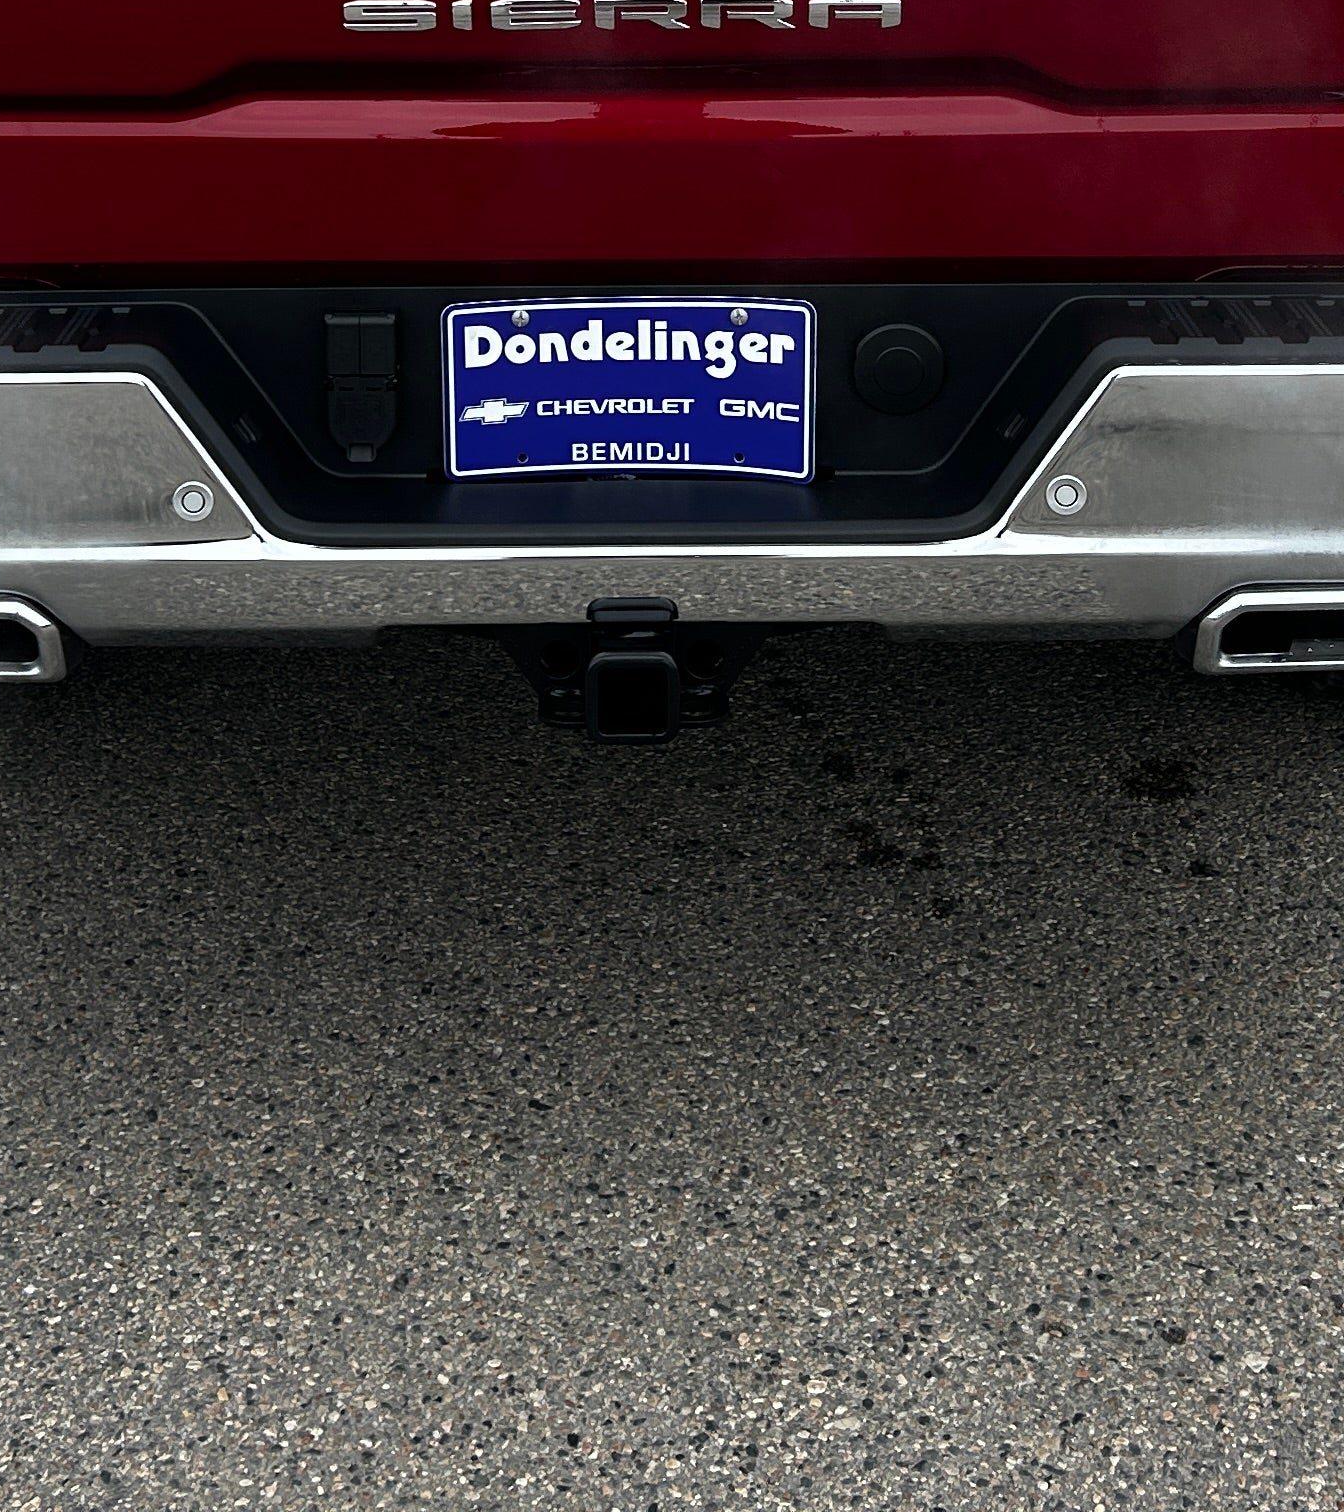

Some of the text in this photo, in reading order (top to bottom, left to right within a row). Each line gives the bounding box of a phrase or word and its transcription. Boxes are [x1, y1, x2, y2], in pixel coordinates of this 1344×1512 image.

[464, 319, 795, 379] Dondelinger
[536, 398, 800, 422] CHEVROLET GMC
[571, 442, 691, 462] BEMIDJI
